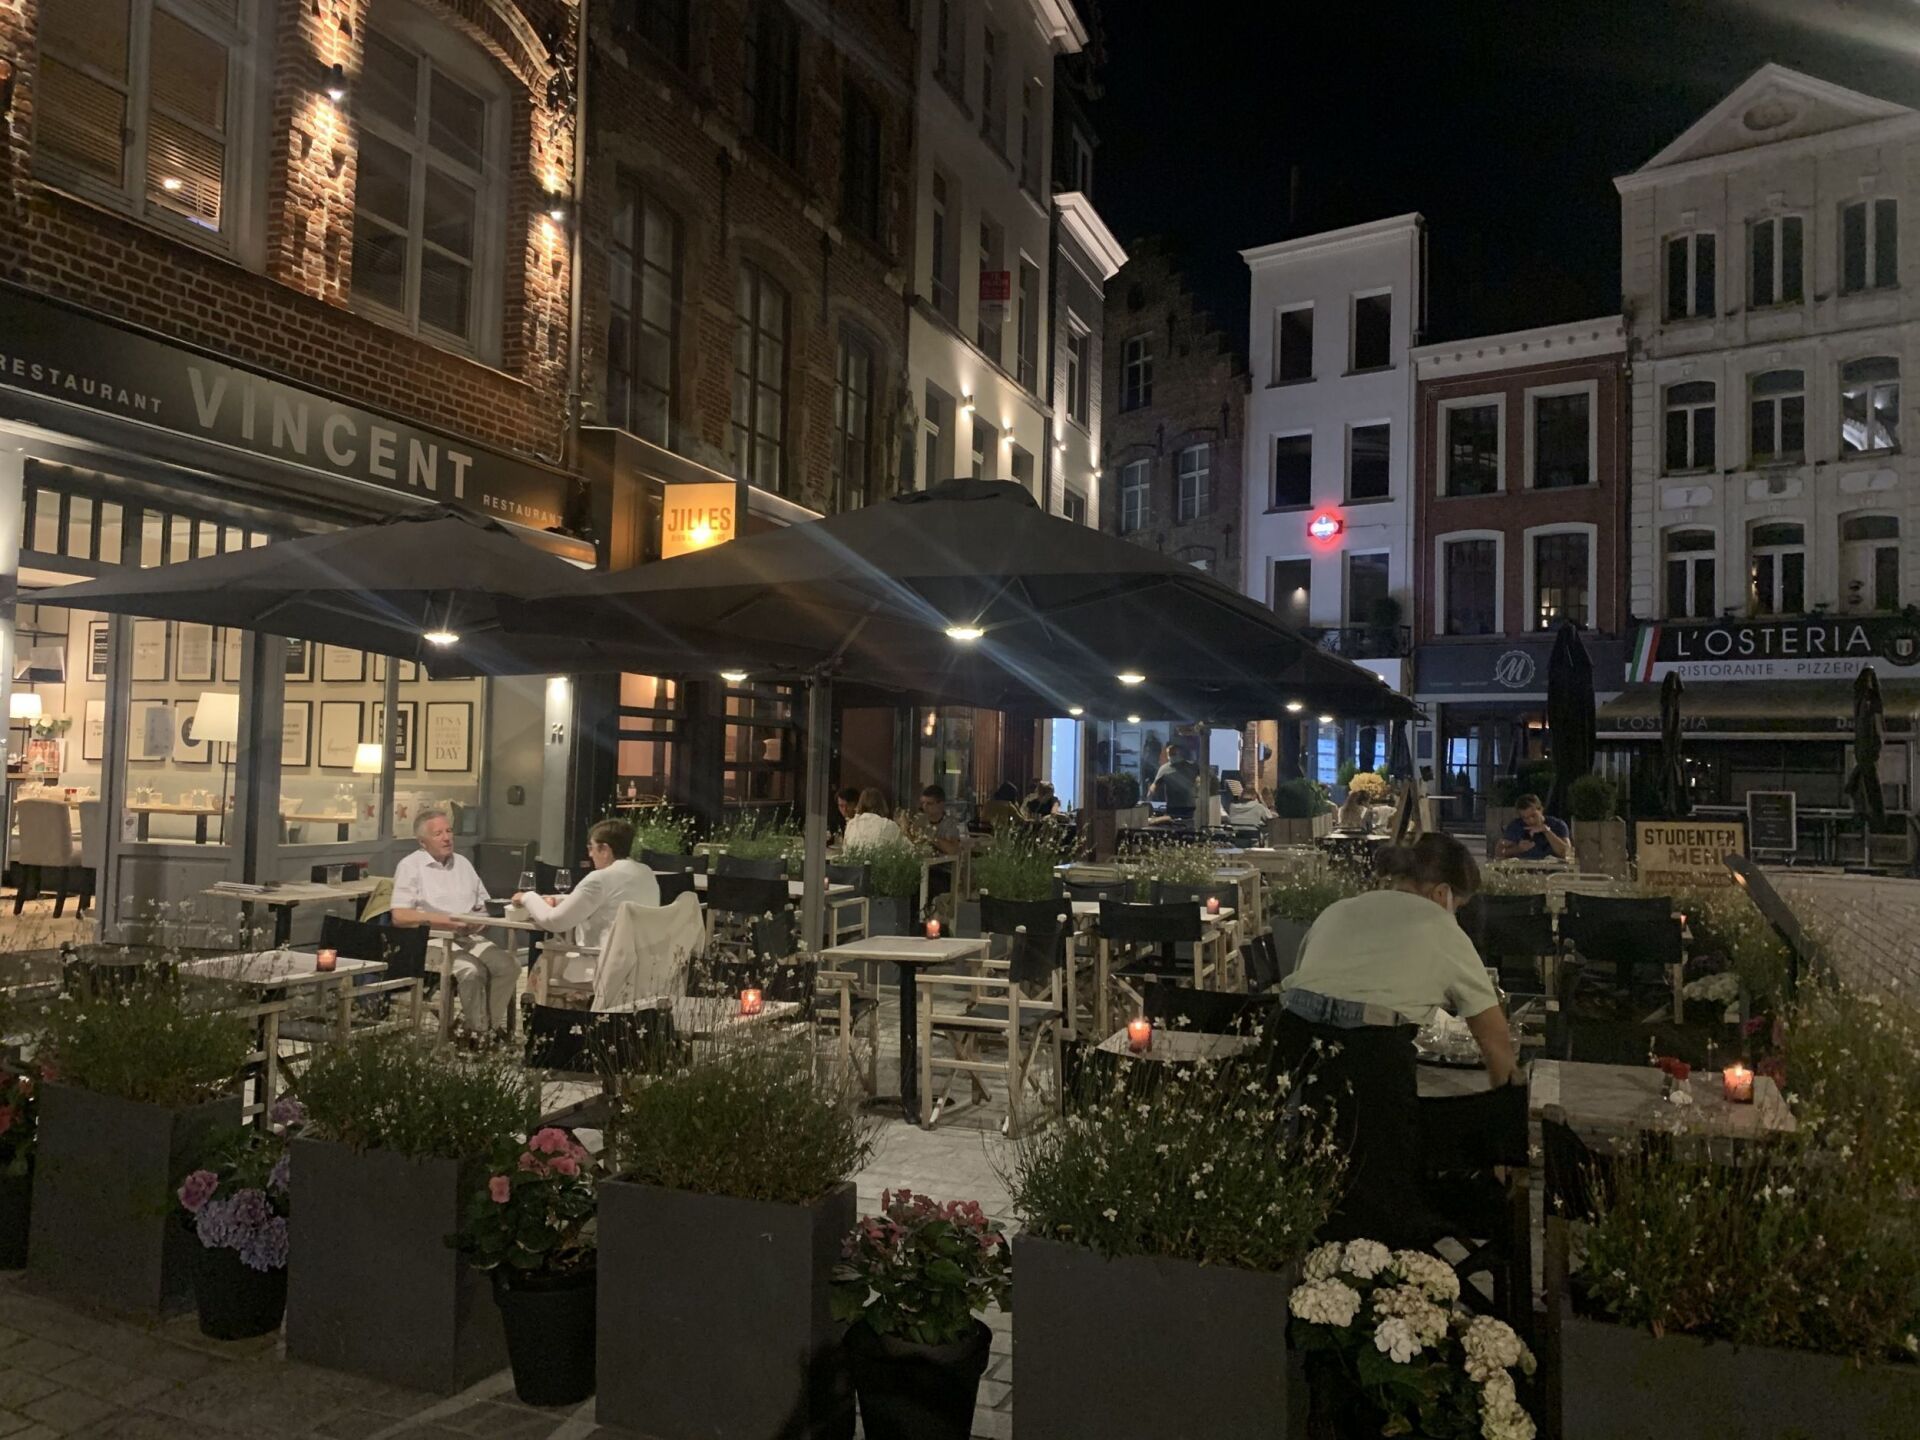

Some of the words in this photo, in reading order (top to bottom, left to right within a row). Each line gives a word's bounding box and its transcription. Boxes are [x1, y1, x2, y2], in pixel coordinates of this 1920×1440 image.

[187, 366, 473, 499] VINCENT
[483, 494, 564, 527] RESTAURANT
[1677, 625, 1872, 656] L'OSTERIA
[1678, 663, 1774, 677] RISTORANTE
[1645, 828, 1736, 847] STUDENTEN
